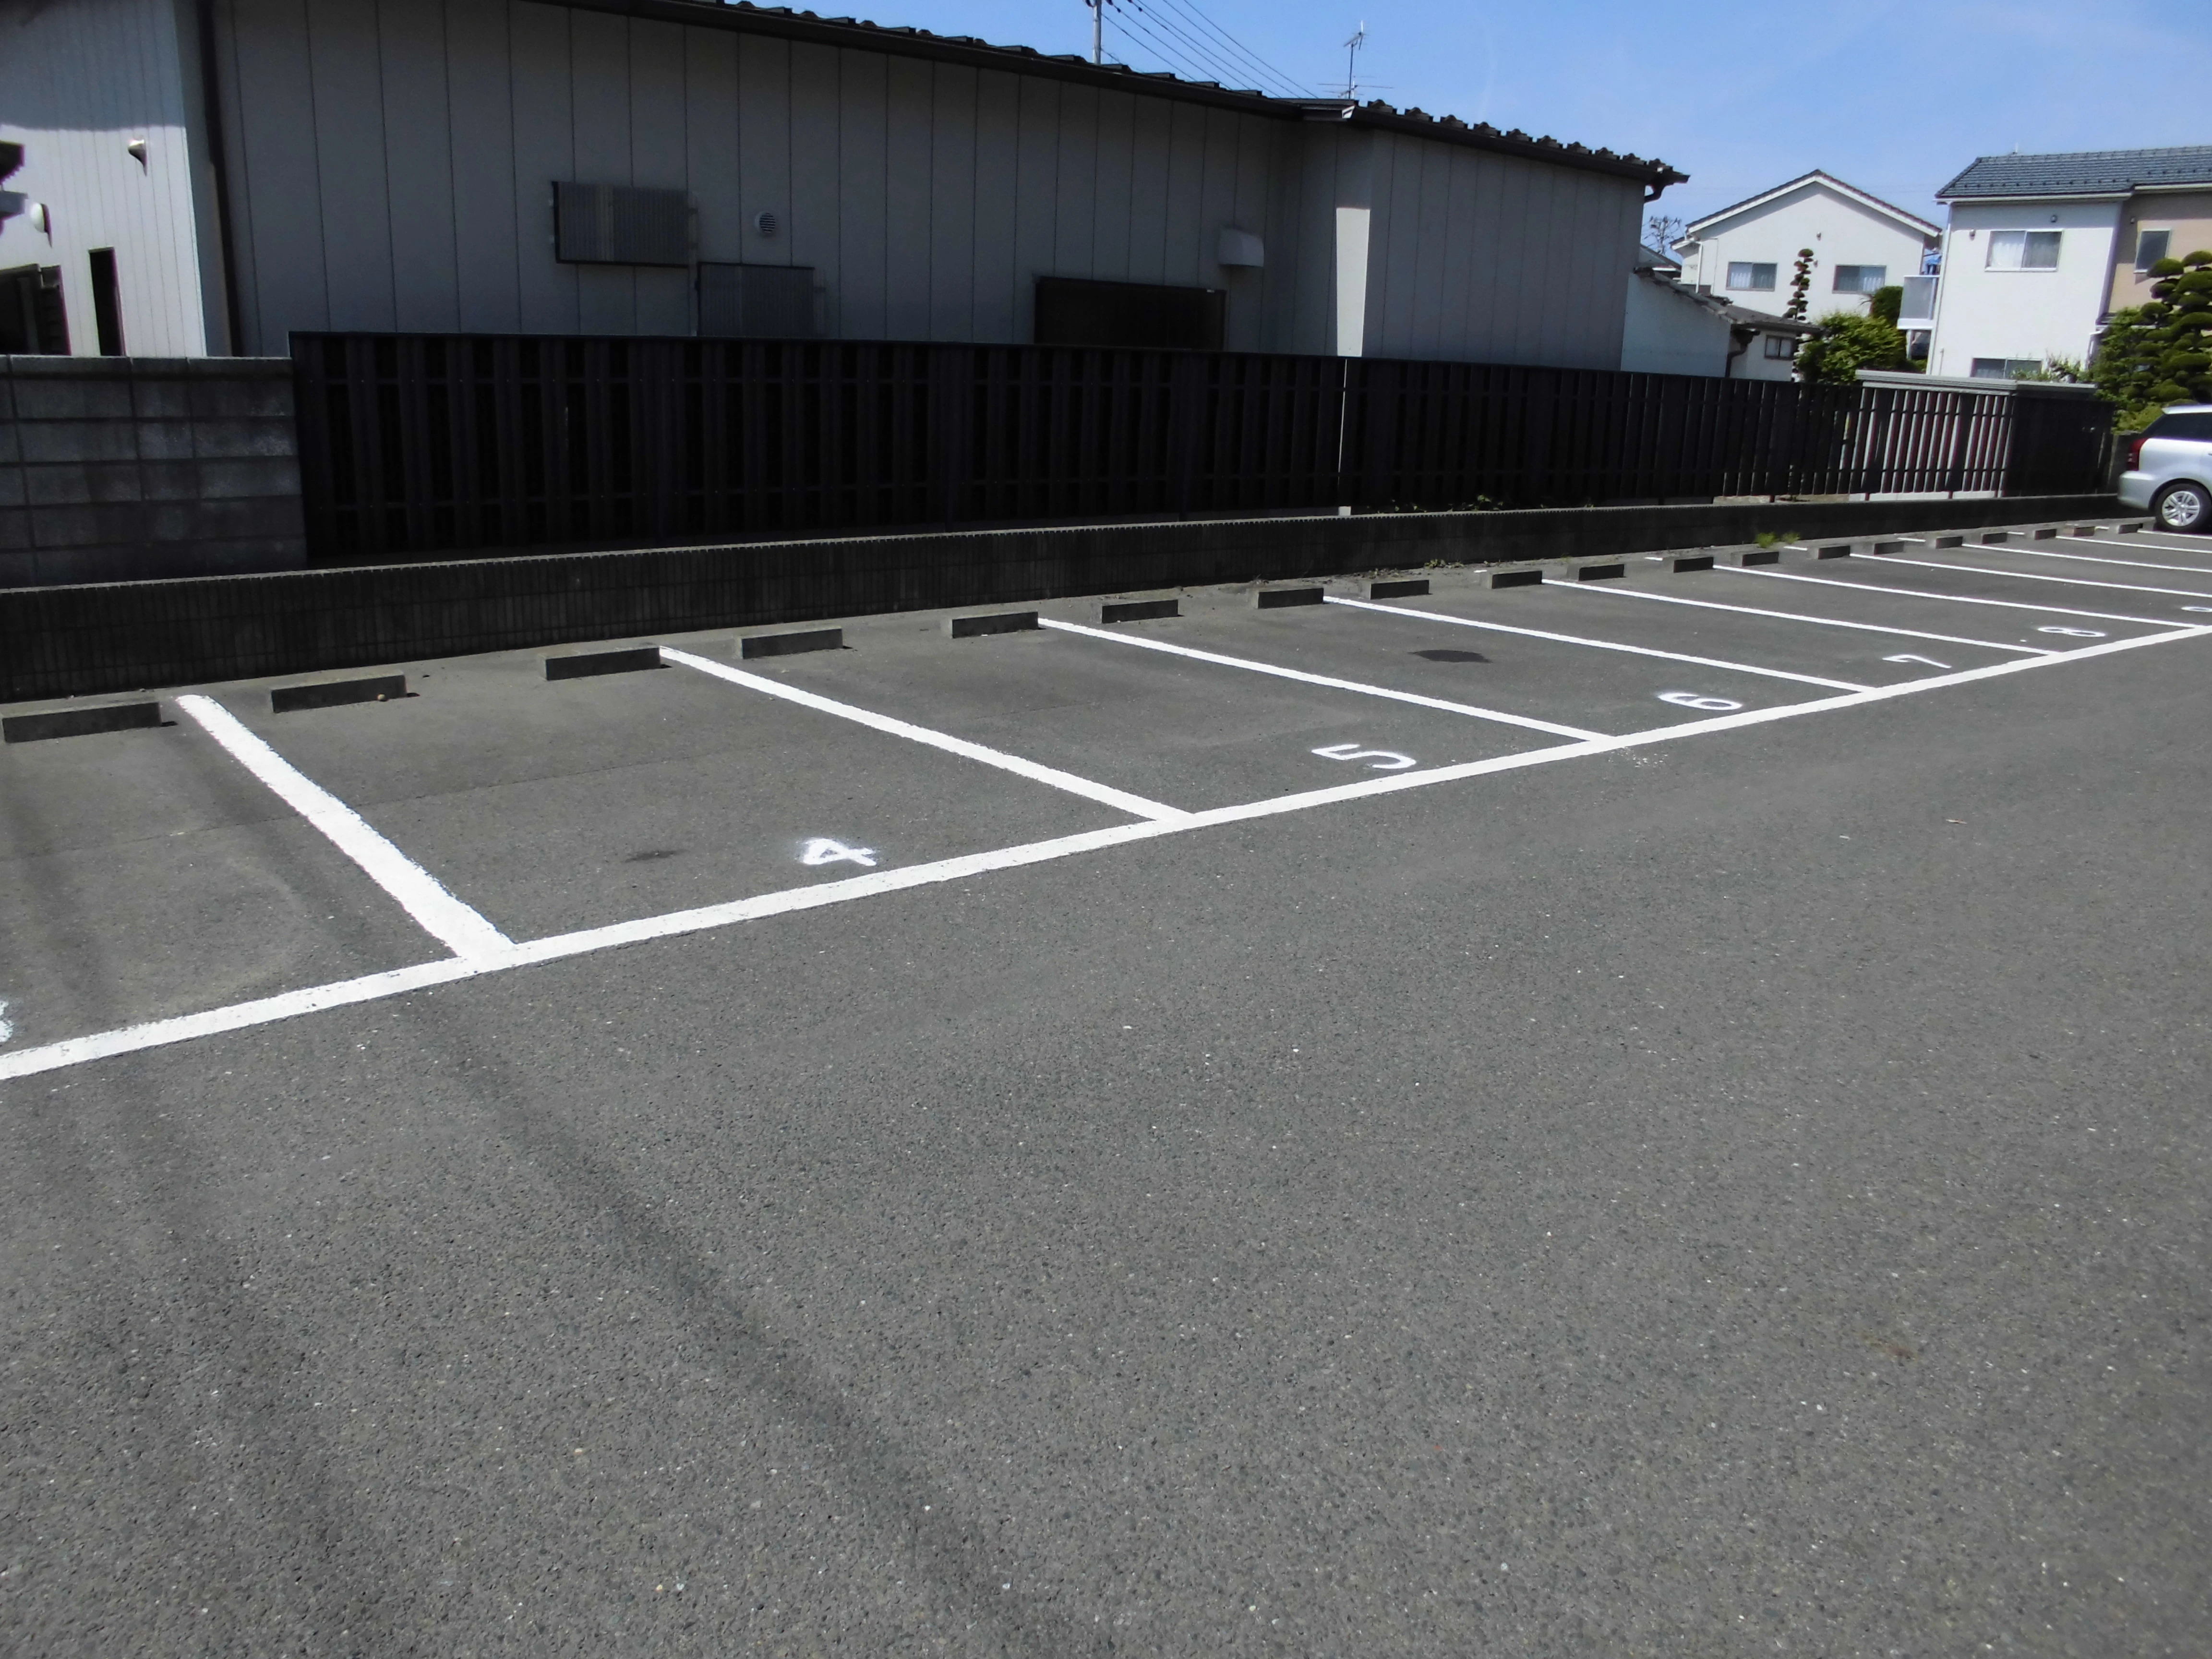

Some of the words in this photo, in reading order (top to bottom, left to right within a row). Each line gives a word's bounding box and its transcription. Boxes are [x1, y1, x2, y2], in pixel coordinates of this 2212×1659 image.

[2036, 626, 2107, 637] 8
[1881, 654, 1952, 669] 7
[1656, 691, 1743, 711] 6
[1310, 743, 1418, 769] 5
[800, 837, 877, 867] 4
